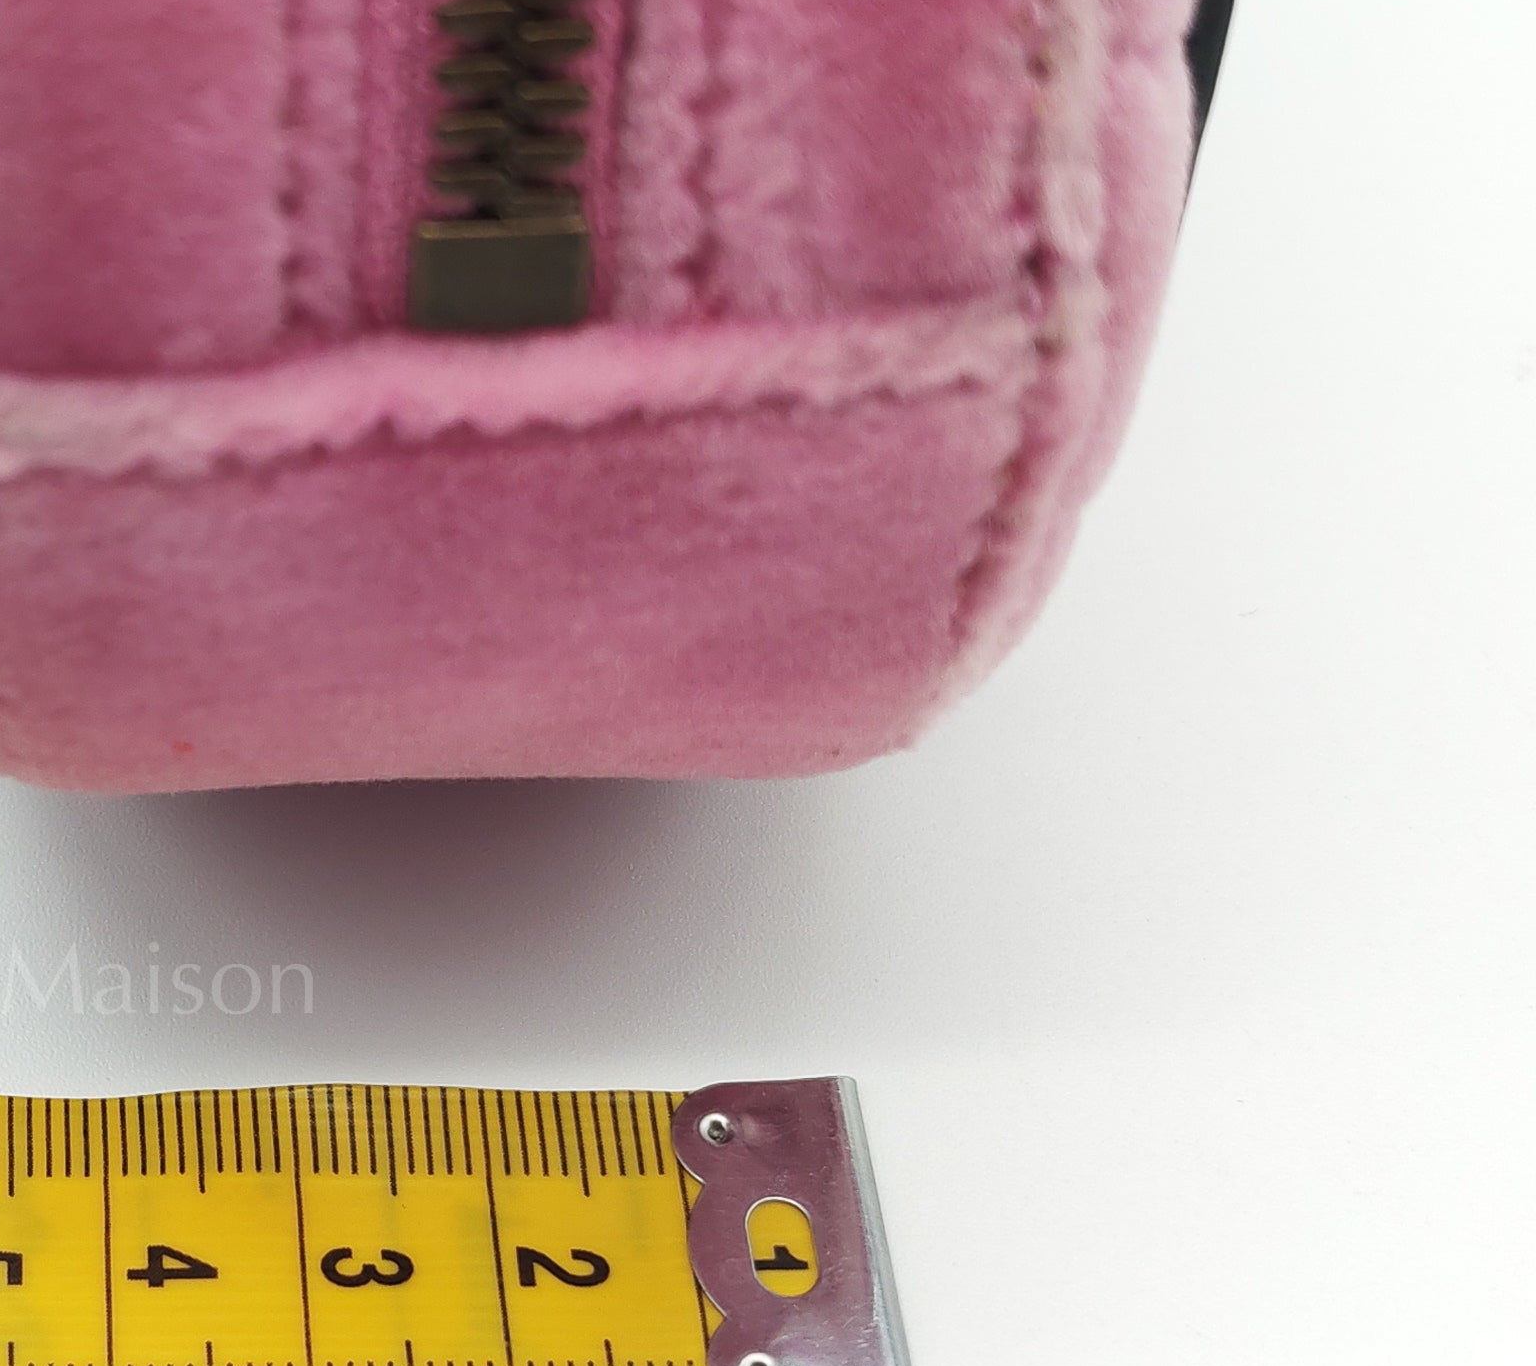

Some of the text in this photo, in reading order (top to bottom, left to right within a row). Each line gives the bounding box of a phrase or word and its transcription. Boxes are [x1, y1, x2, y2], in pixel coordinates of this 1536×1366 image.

[124, 1243, 220, 1290] 4
[318, 1245, 417, 1290] 3
[516, 1244, 613, 1290] 2
[751, 1243, 811, 1275] 1
